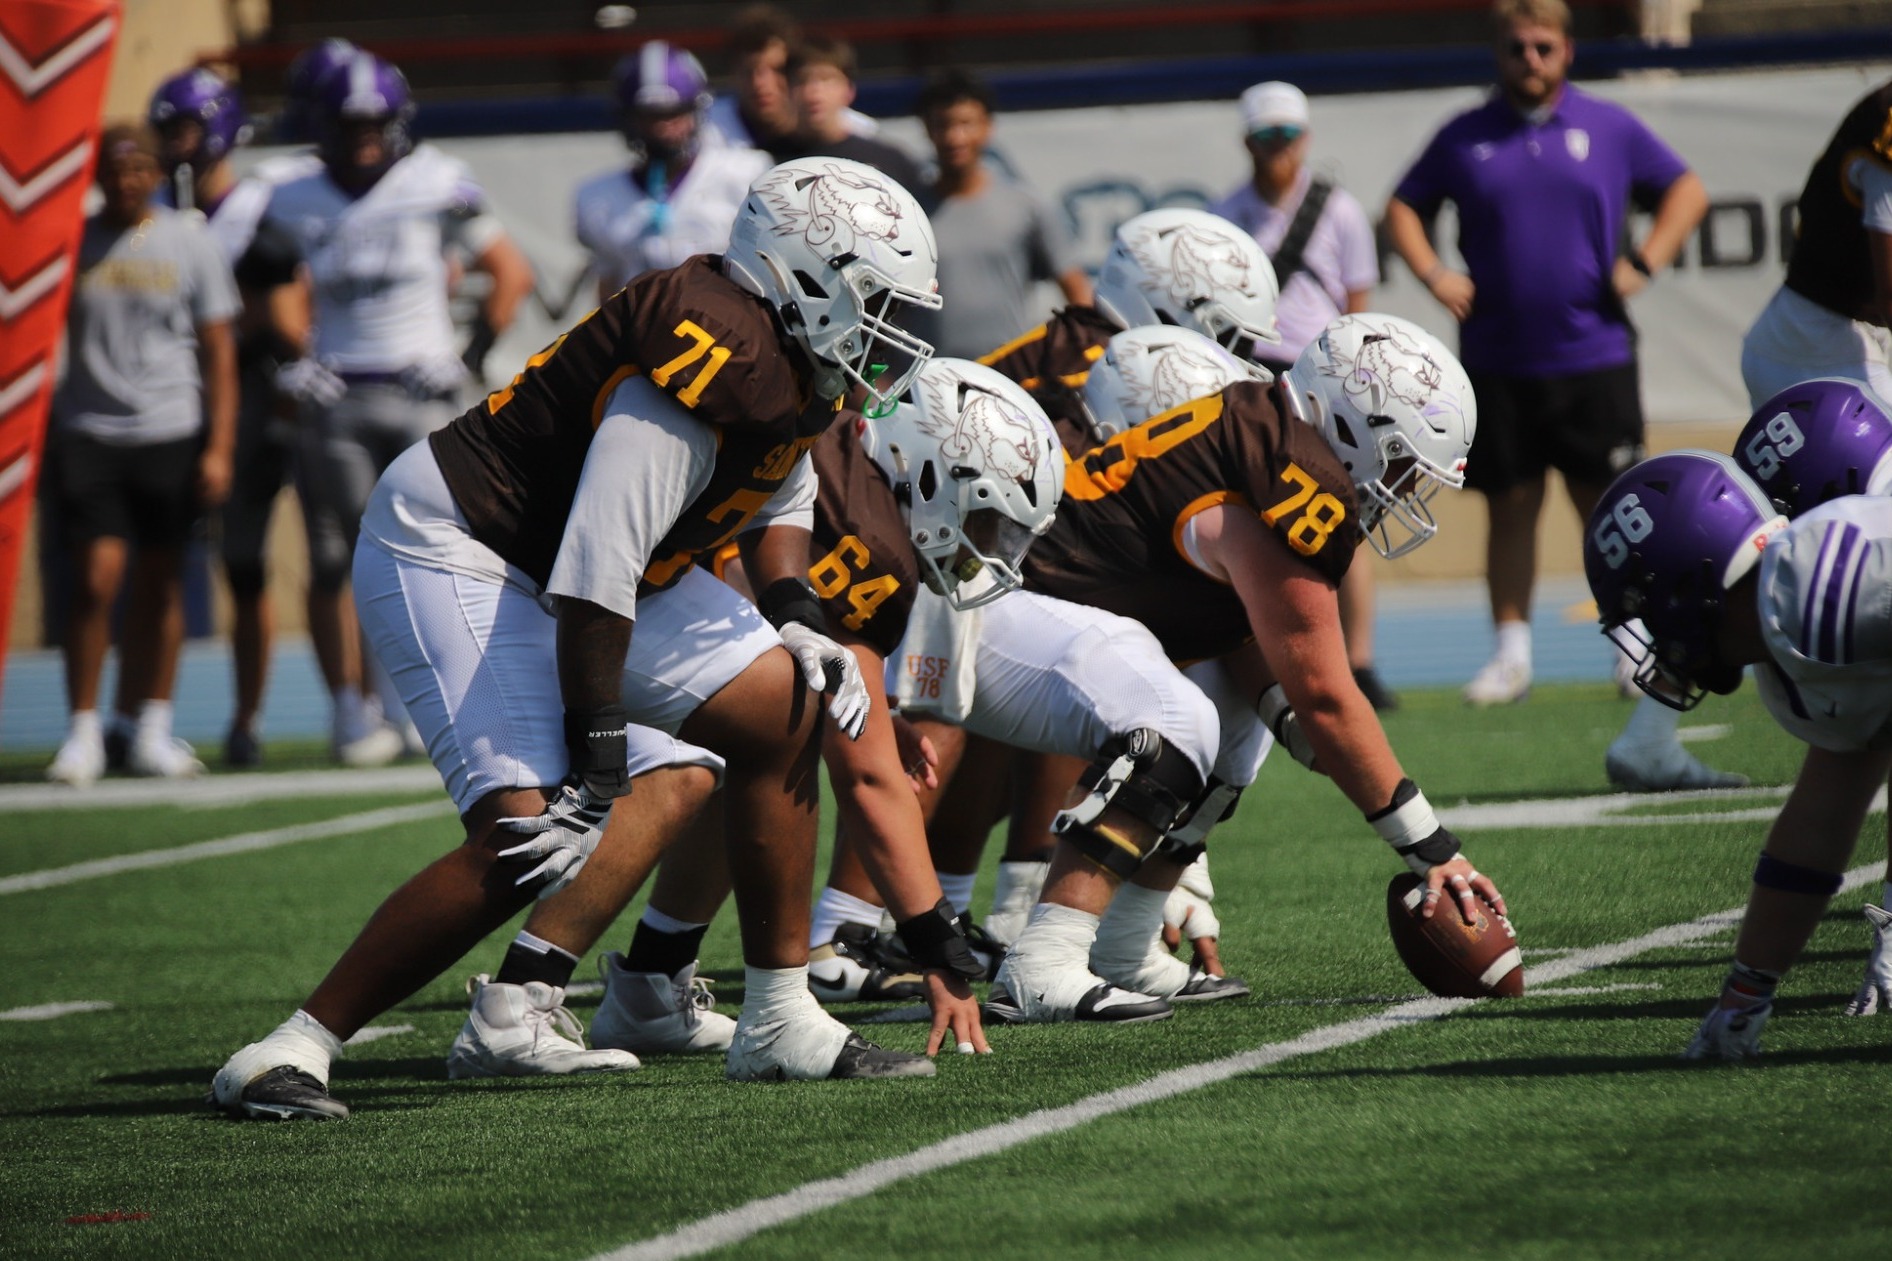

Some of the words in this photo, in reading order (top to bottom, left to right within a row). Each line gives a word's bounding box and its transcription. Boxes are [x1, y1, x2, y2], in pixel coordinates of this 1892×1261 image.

[652, 319, 732, 409] 71
[1746, 412, 1805, 481] 59
[1260, 462, 1346, 556] 78
[1594, 493, 1654, 570] 56
[808, 535, 900, 631] 64
[906, 655, 950, 678] USF
[916, 677, 941, 699] 78
